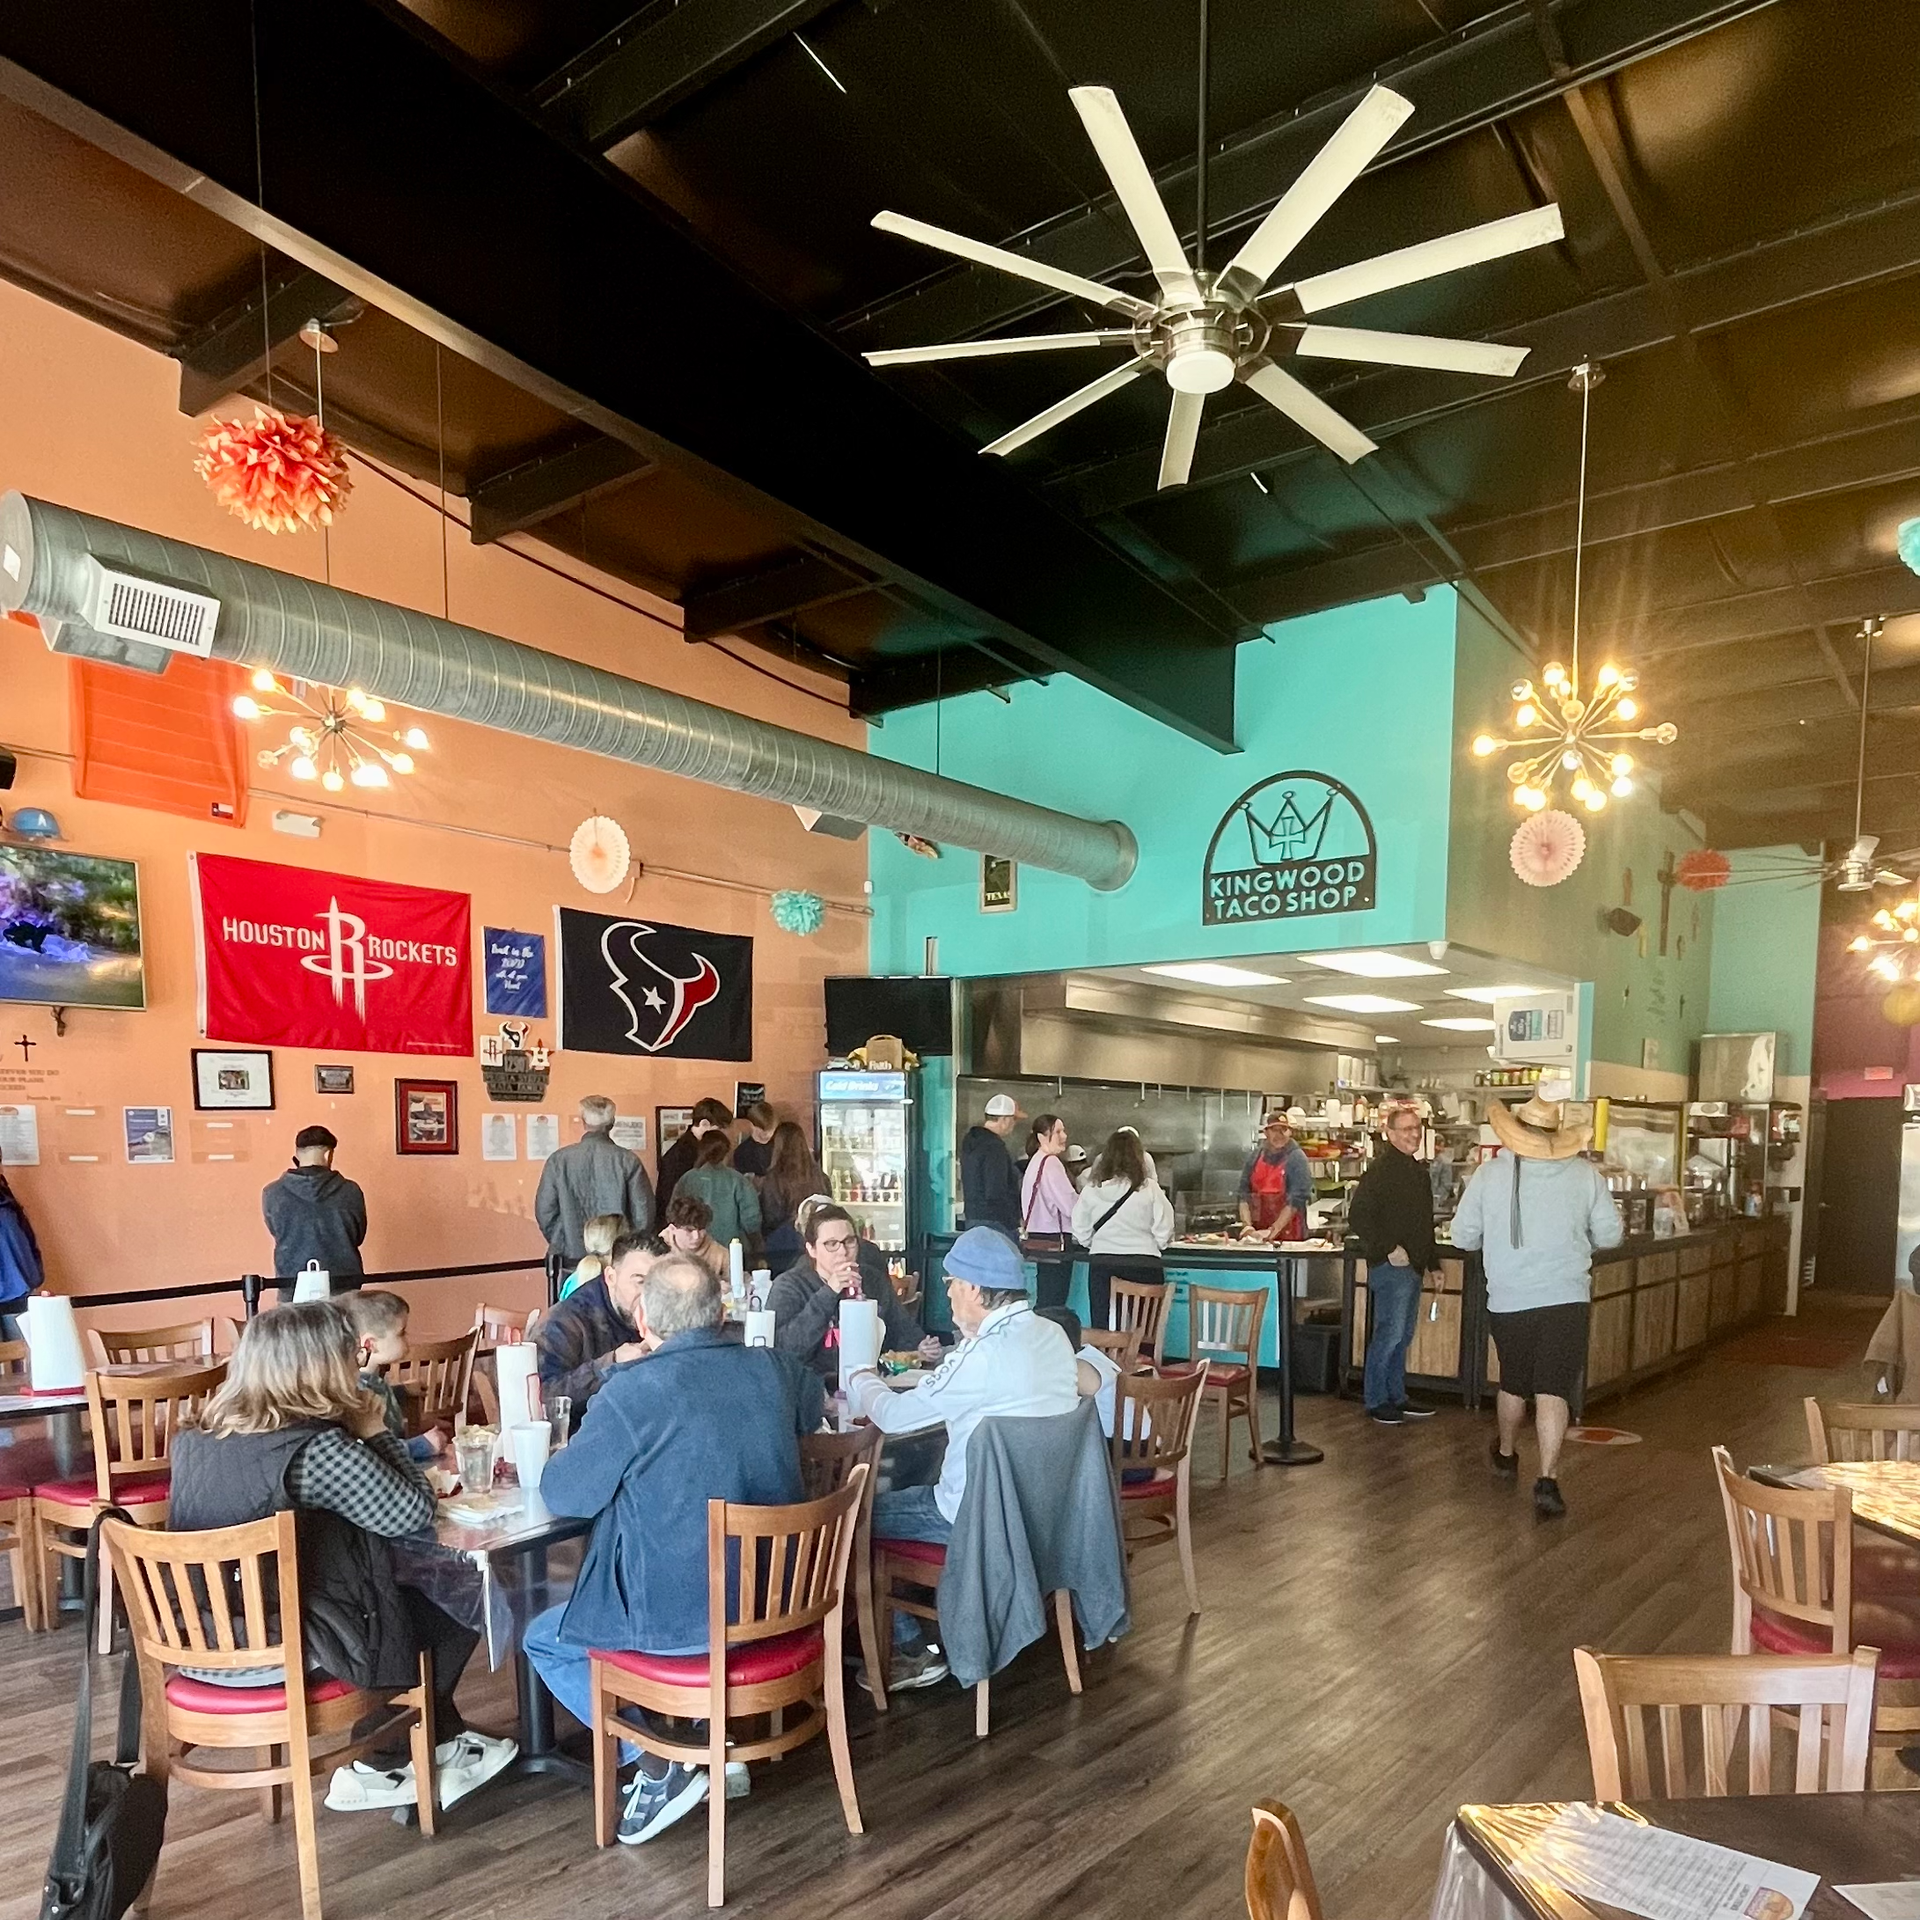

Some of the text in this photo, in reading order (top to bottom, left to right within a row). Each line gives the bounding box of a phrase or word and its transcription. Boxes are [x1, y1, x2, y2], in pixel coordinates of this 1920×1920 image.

[1210, 861, 1365, 898] KINGWOOD
[1214, 886, 1357, 919] TACO SHOP
[222, 916, 326, 951] HOUSTON
[366, 934, 458, 967] ROCKETS
[825, 1080, 879, 1092] Cold Drinks
